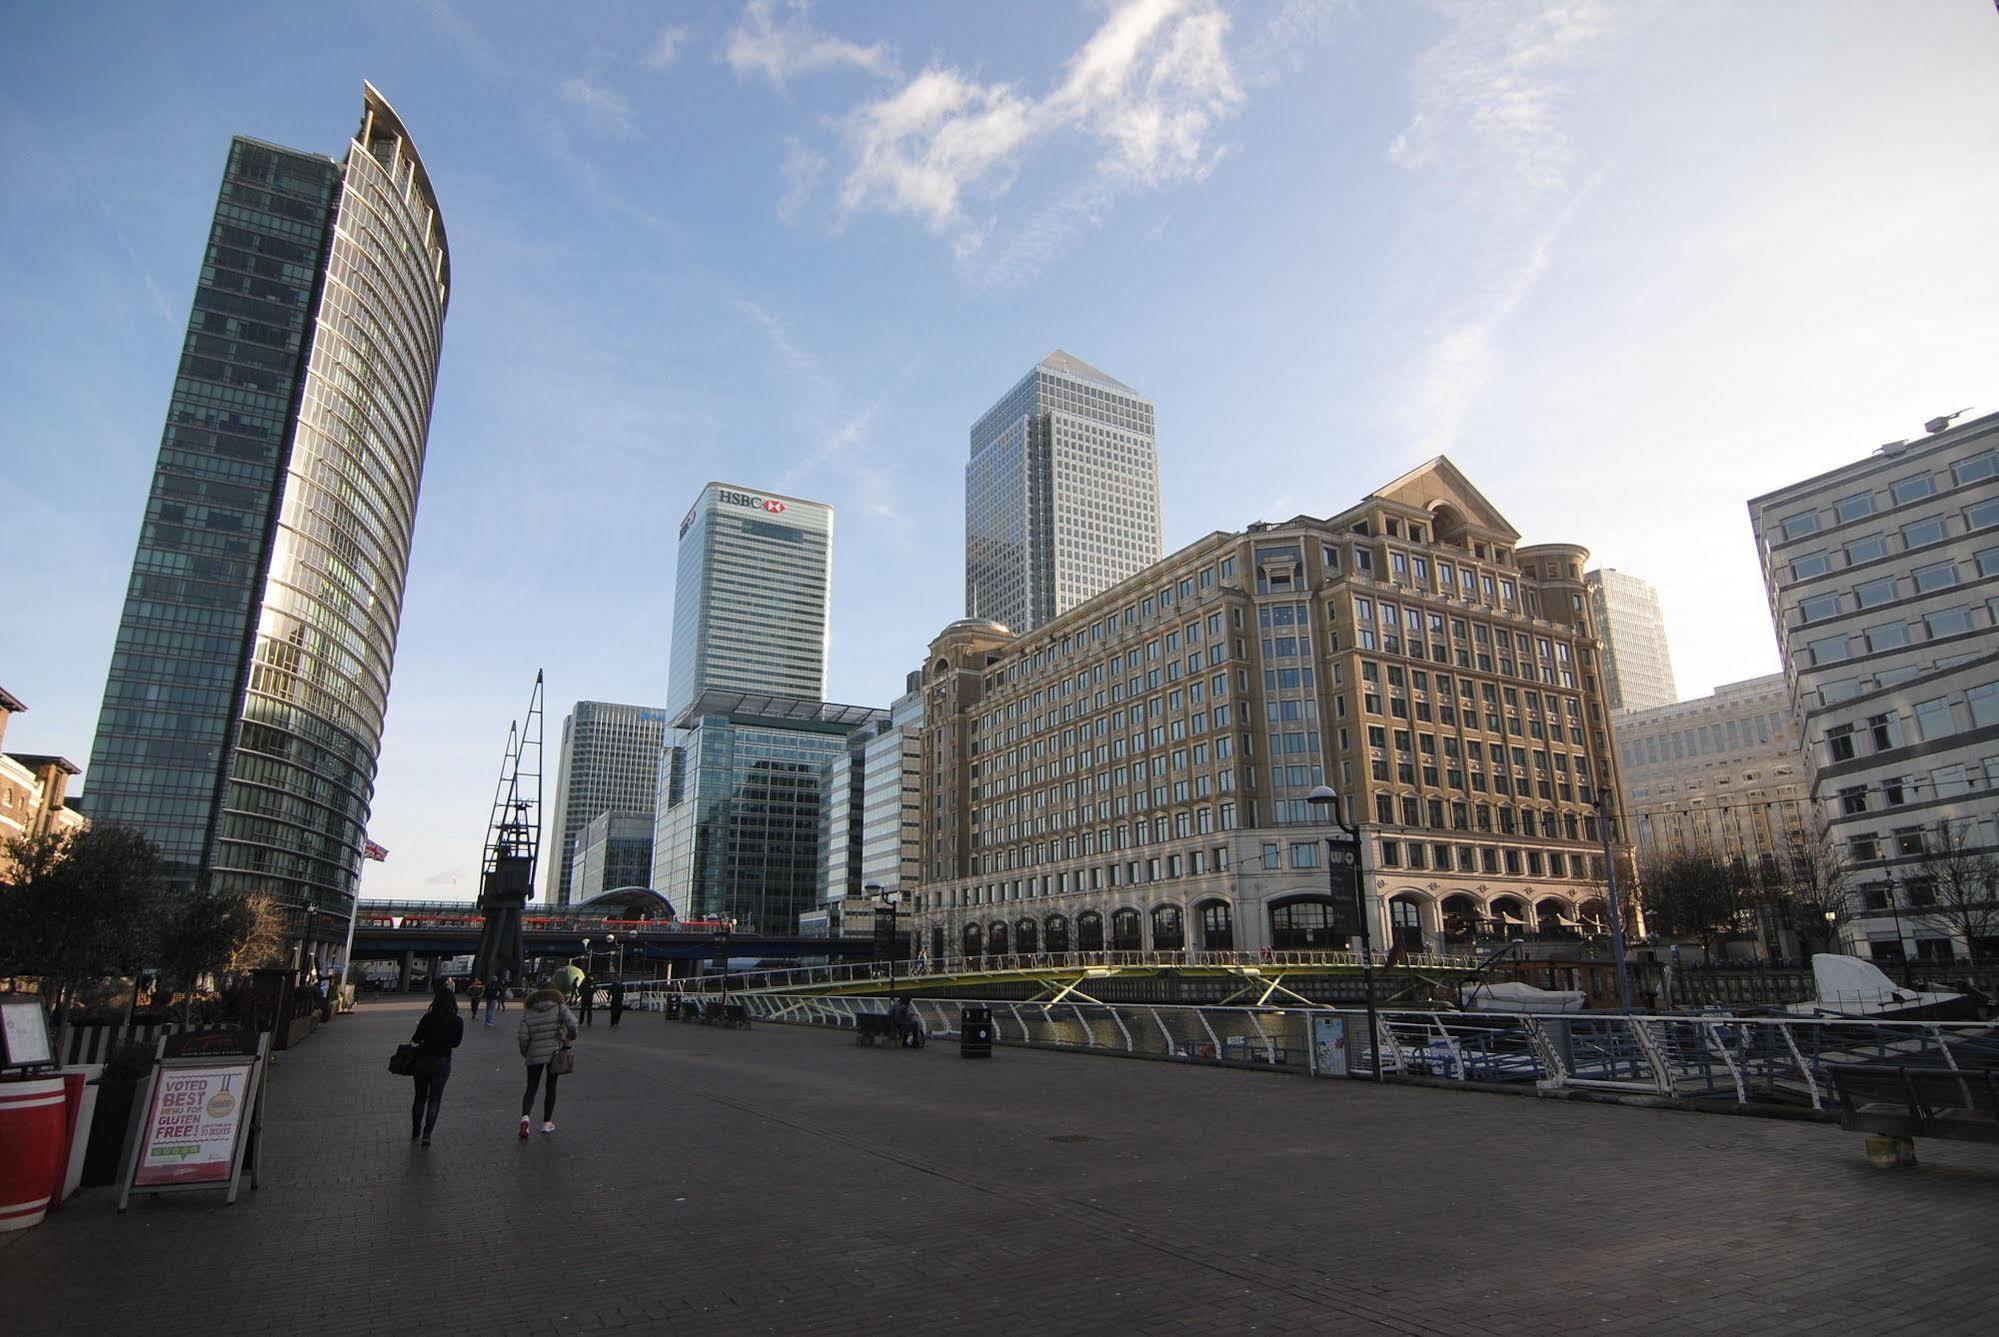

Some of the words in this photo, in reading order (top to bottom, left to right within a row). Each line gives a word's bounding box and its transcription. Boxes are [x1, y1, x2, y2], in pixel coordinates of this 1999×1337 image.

[719, 490, 762, 509] HSBC
[166, 1080, 208, 1092] VOTED
[162, 1091, 206, 1107] BEST
[187, 1106, 202, 1114] FOR
[158, 1114, 201, 1125] GLUTEN
